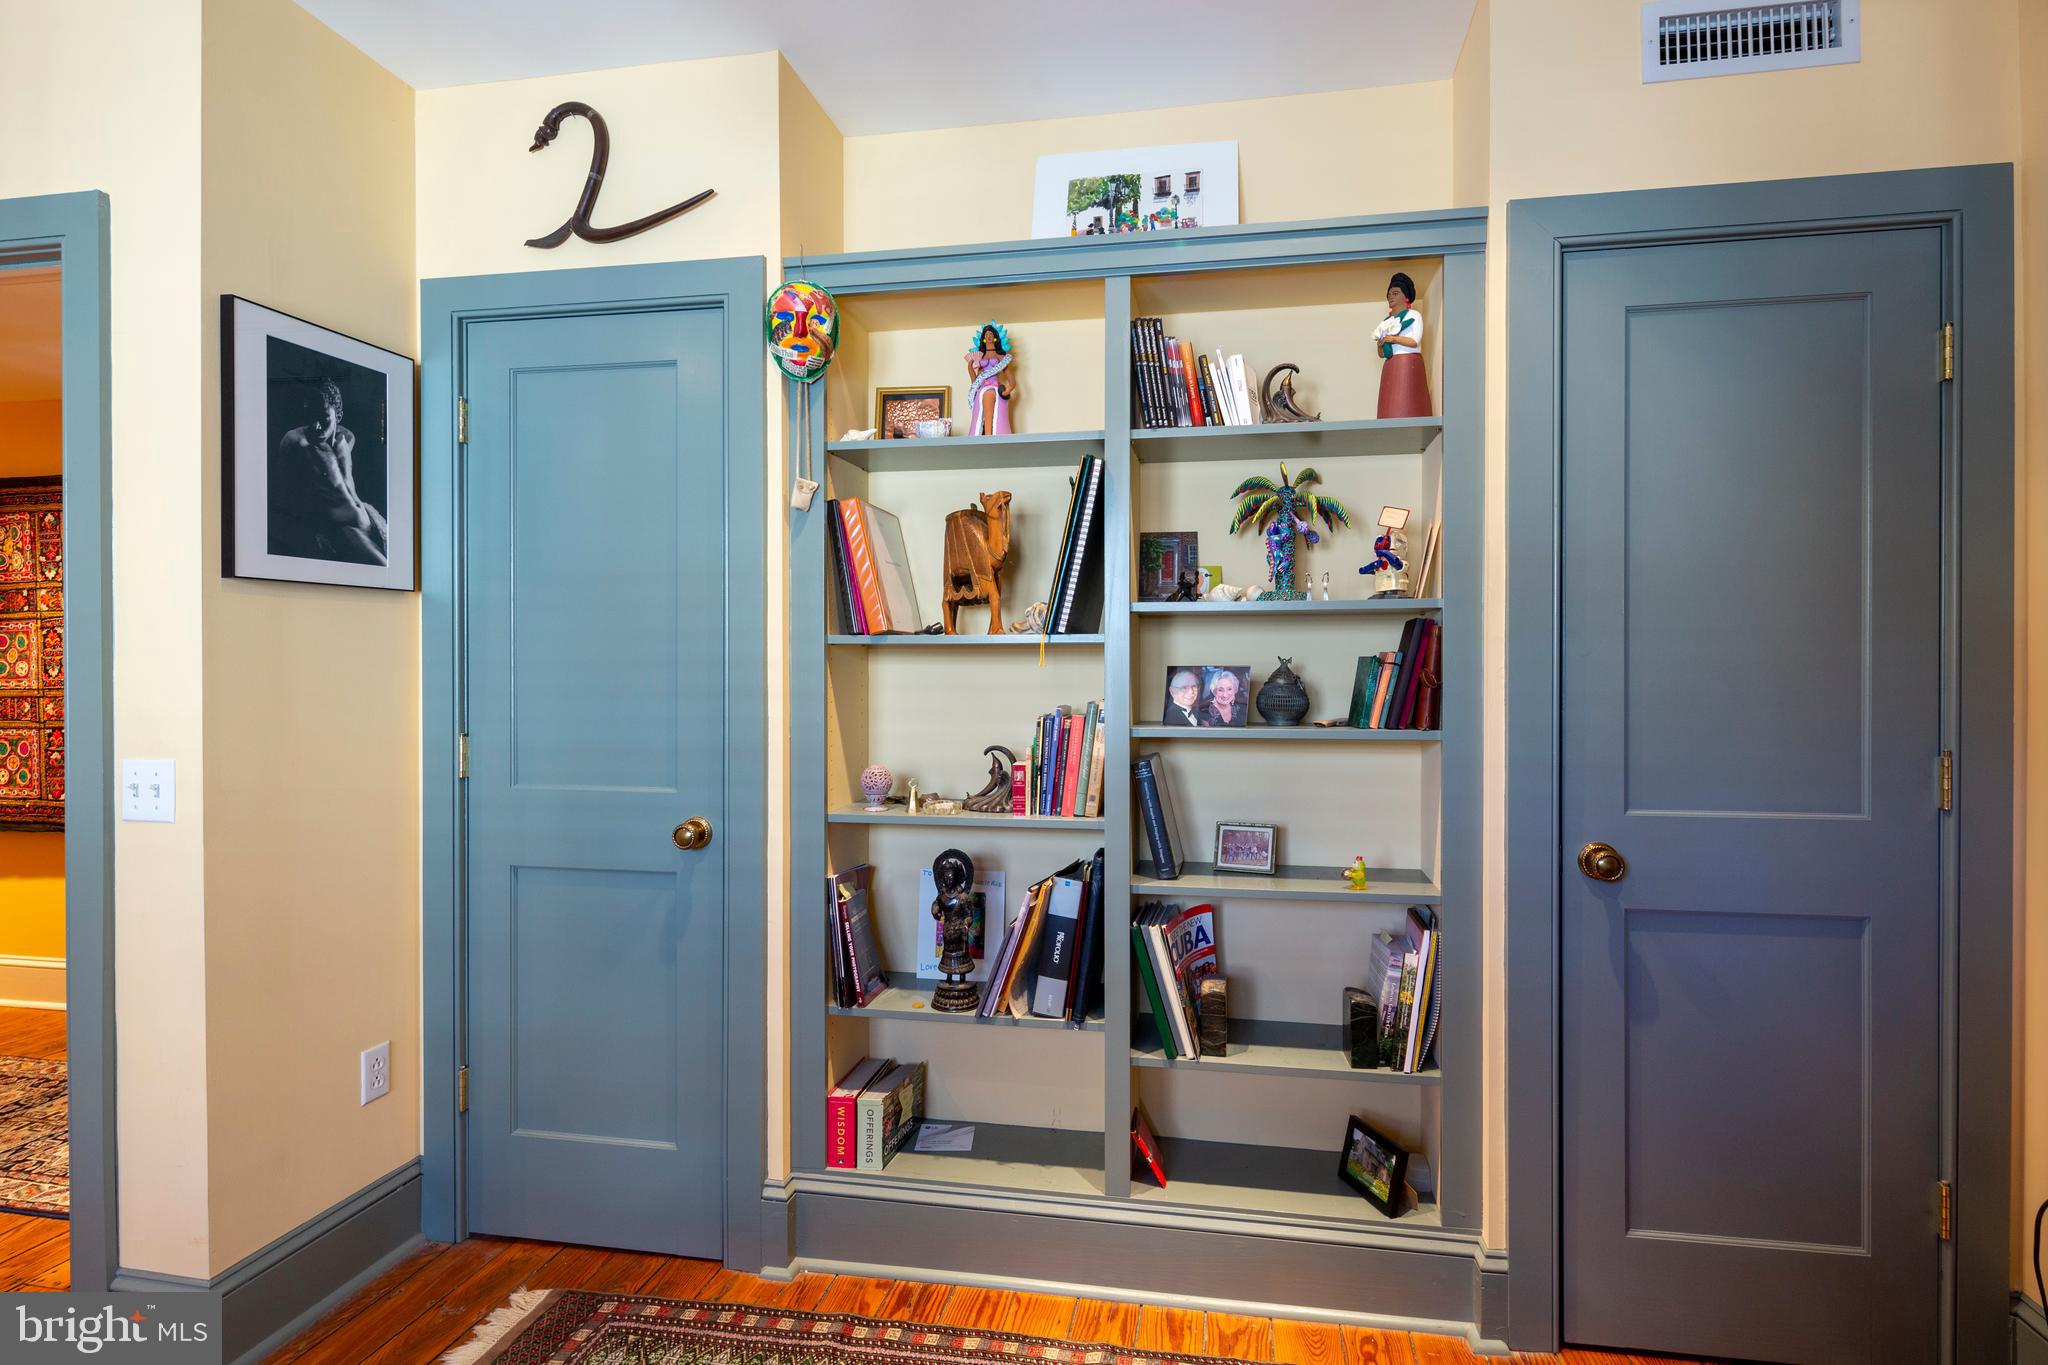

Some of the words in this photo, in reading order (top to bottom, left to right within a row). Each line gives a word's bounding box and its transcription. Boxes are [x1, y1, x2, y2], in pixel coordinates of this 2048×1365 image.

[844, 922, 852, 942] SELLING
[852, 956, 860, 992] PHOTOGRAPHY
[1170, 925, 1212, 967] CUBA
[836, 1106, 846, 1156] WISDOM
[865, 1109, 874, 1164] OFFERINGS
[884, 1120, 914, 1156] OFFERINGS
